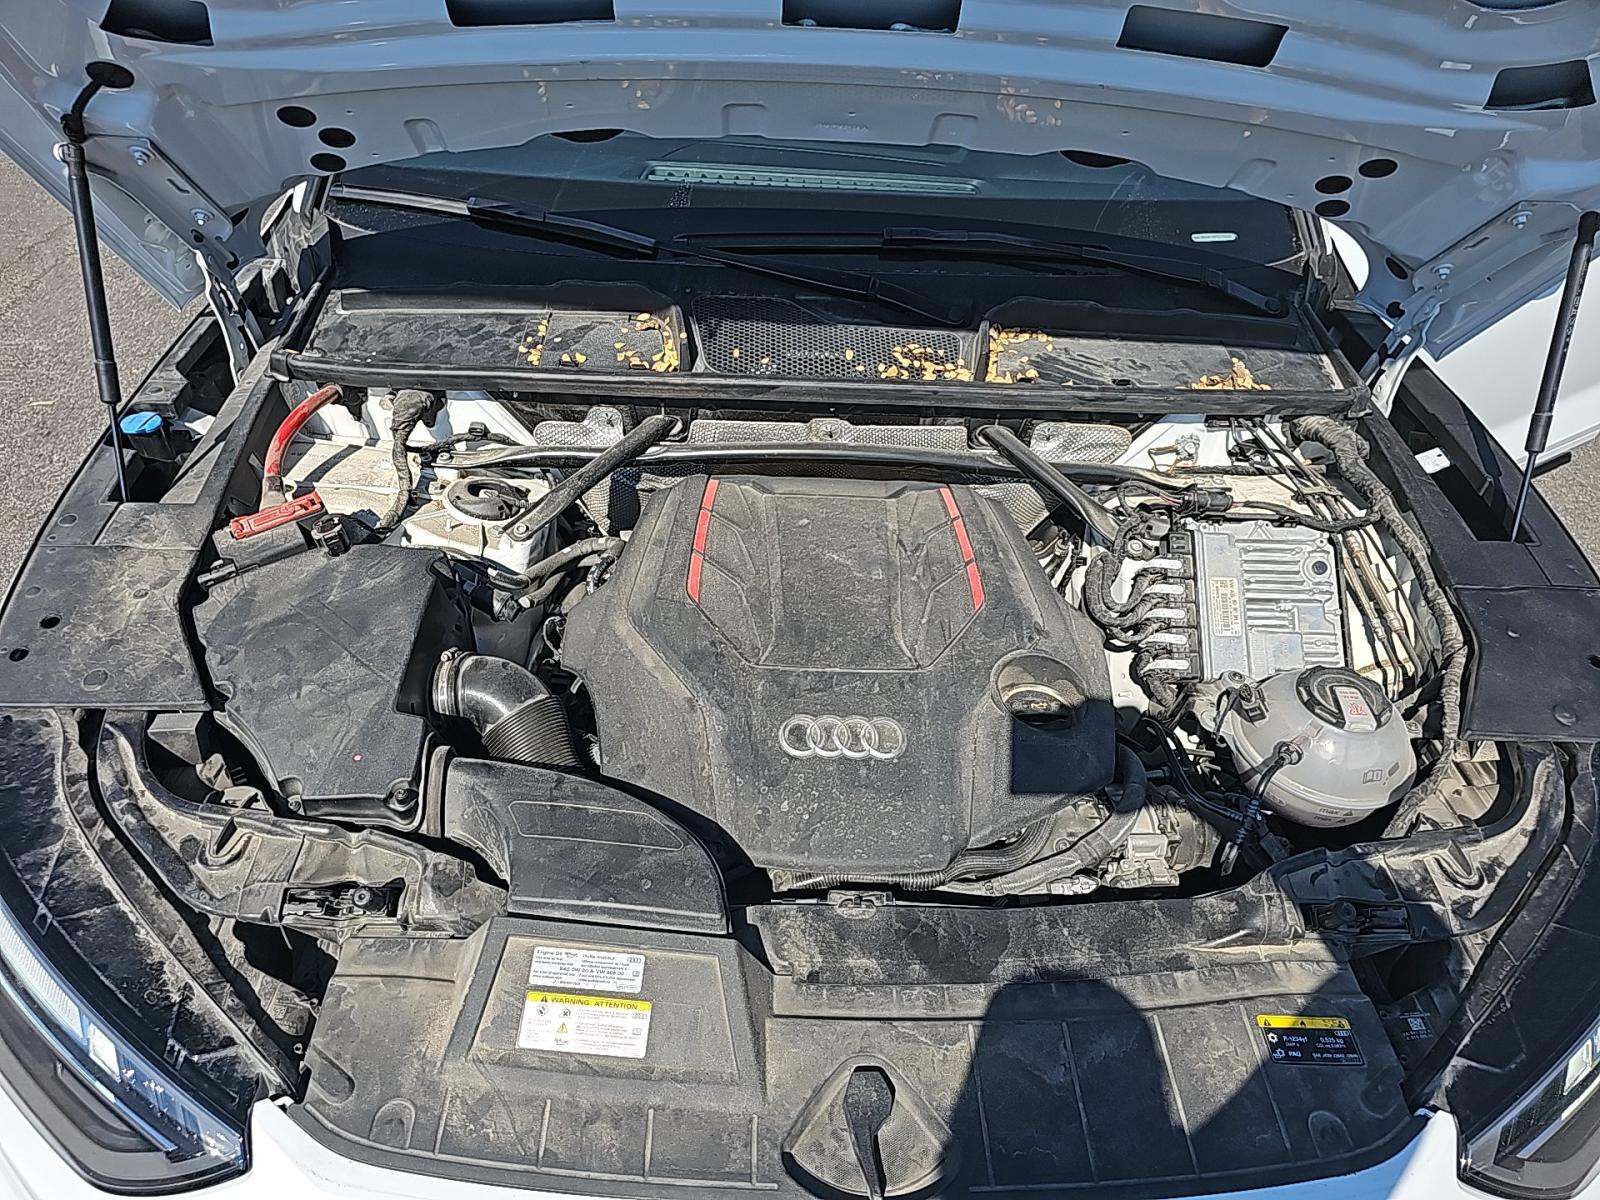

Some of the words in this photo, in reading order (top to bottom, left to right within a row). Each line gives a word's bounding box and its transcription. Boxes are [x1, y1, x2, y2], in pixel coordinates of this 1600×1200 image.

[537, 949, 554, 957] Engine
[550, 997, 590, 1006] WARNING
[594, 1001, 639, 1010] ATTENTION
